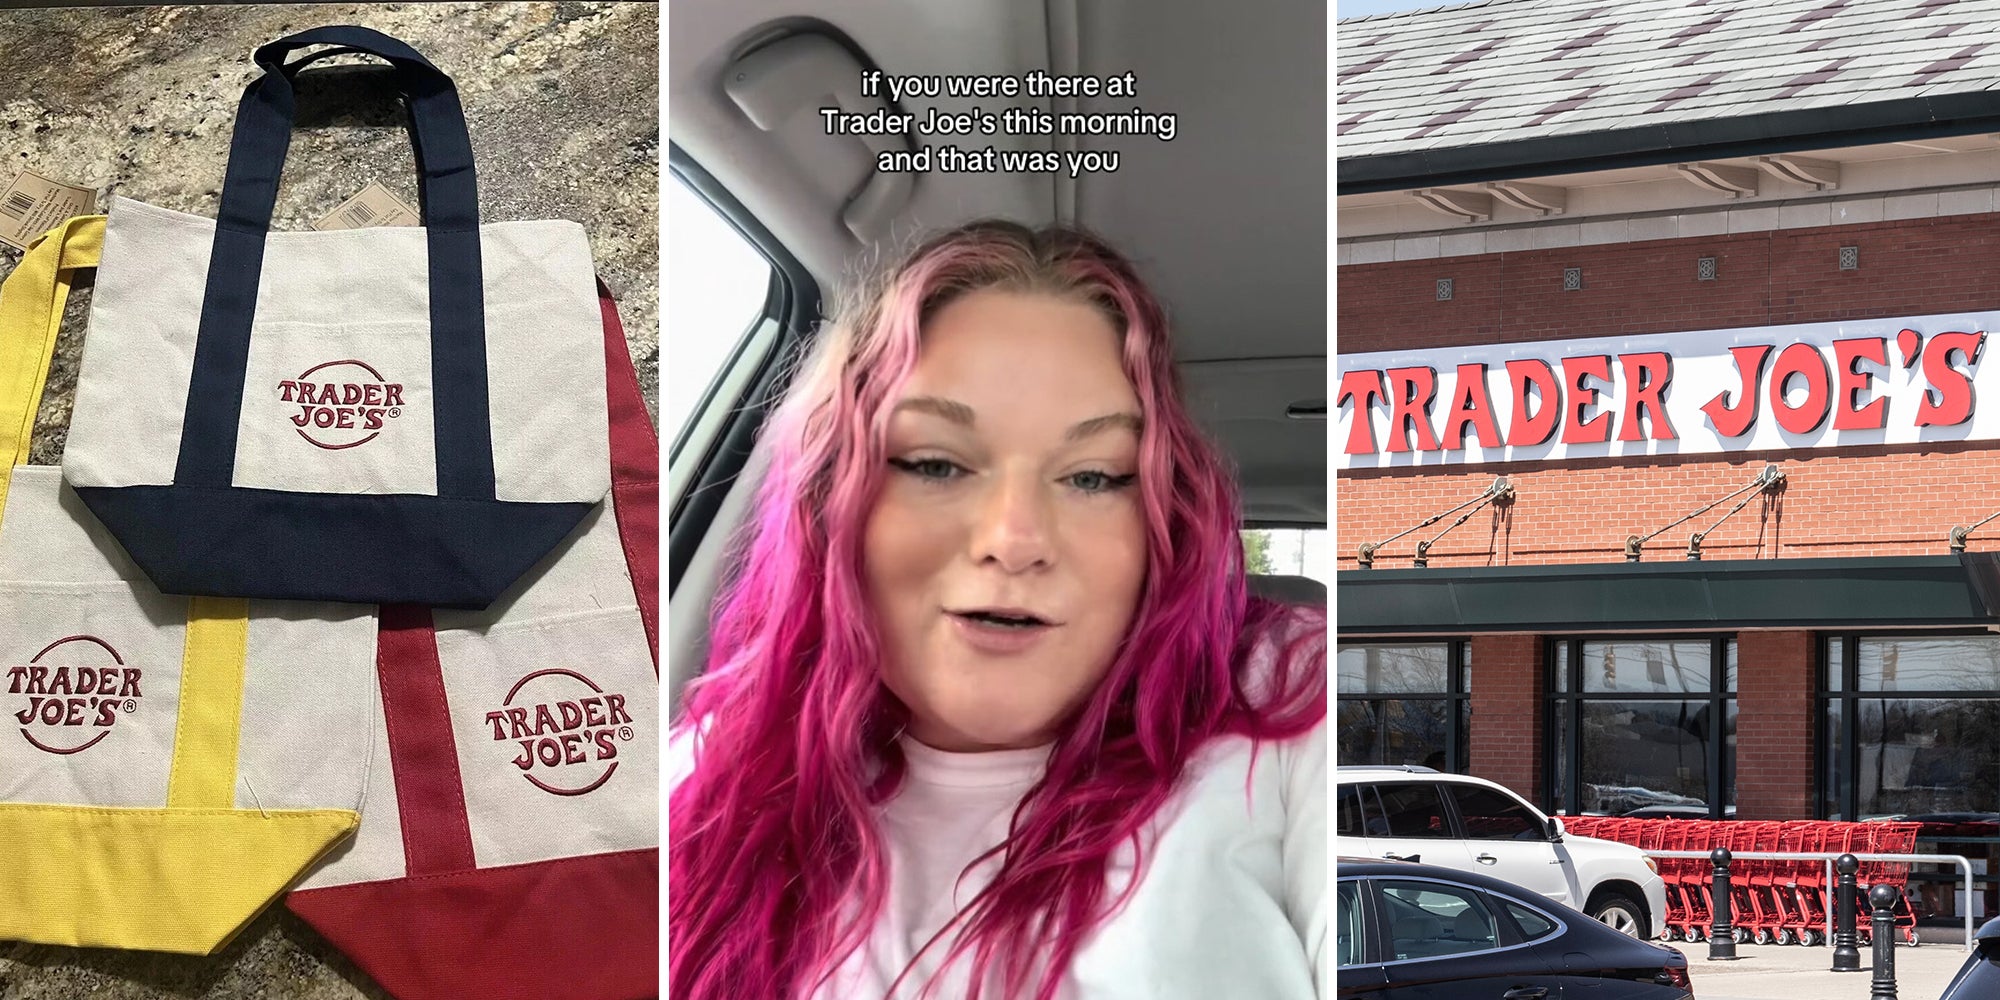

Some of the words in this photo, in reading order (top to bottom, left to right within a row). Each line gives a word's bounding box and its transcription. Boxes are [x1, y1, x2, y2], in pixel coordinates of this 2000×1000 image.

[277, 380, 405, 406] TRADER
[1337, 351, 1681, 455] TRADER
[1699, 328, 1989, 438] JOE'S
[6, 666, 143, 697] TRADER
[485, 694, 633, 741] TRADER
